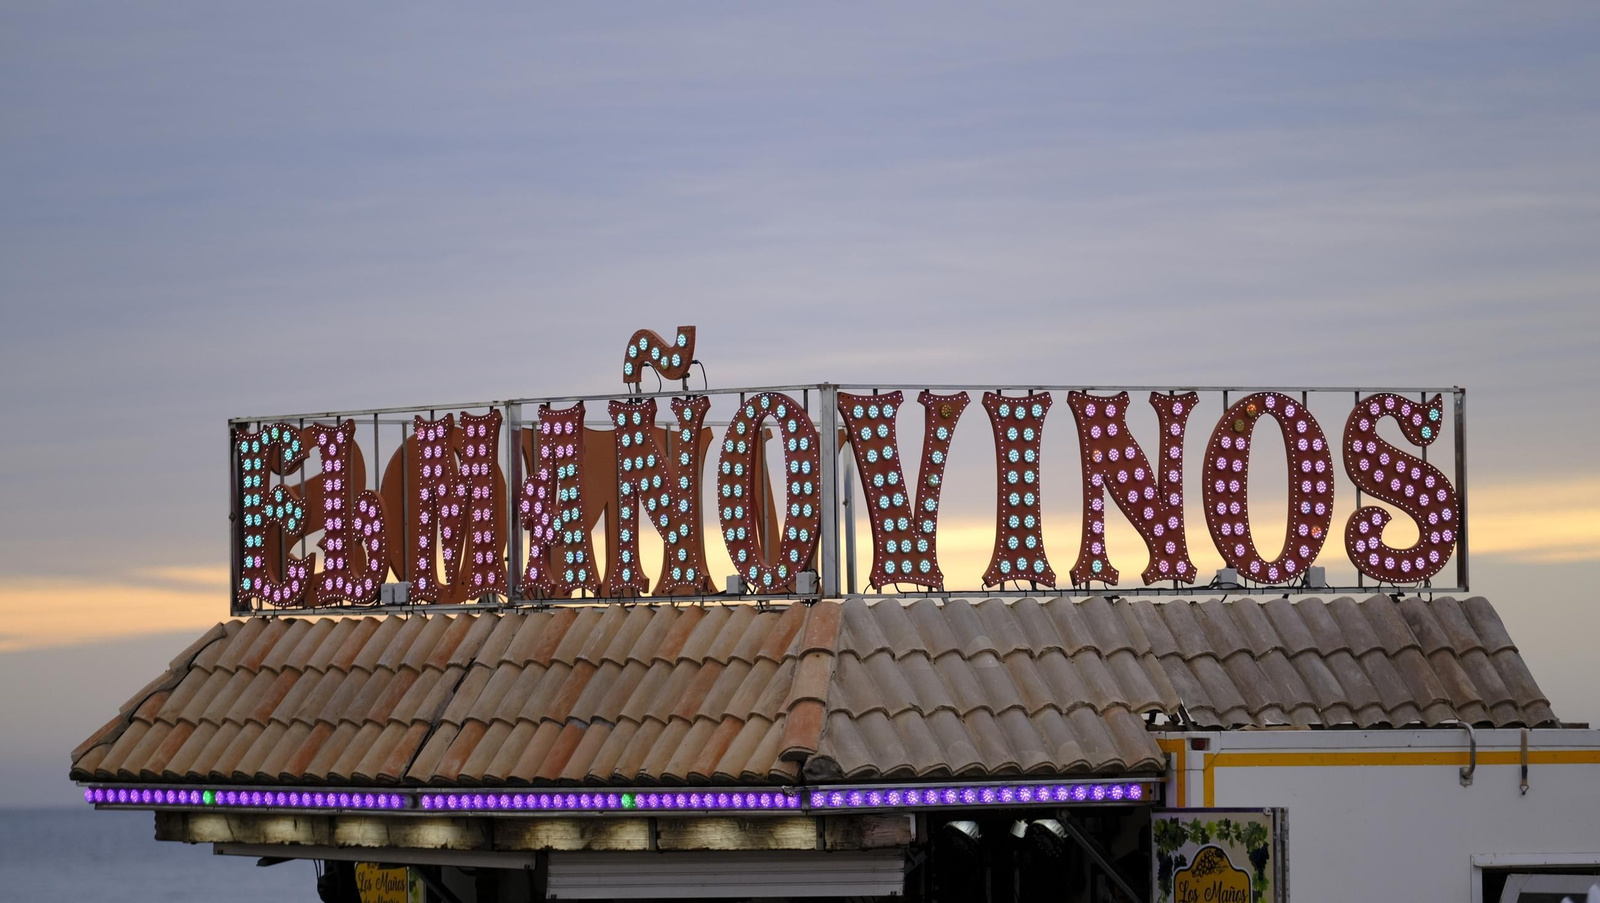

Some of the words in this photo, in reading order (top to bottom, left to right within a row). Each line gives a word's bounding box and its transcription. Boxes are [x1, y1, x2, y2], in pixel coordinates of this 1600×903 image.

[412, 326, 822, 603] MAÑO
[838, 390, 1458, 593] VINOS
[357, 870, 372, 893] Los
[376, 871, 405, 895] Maños
[1178, 880, 1200, 903] Los
[1204, 880, 1248, 903] Maños
